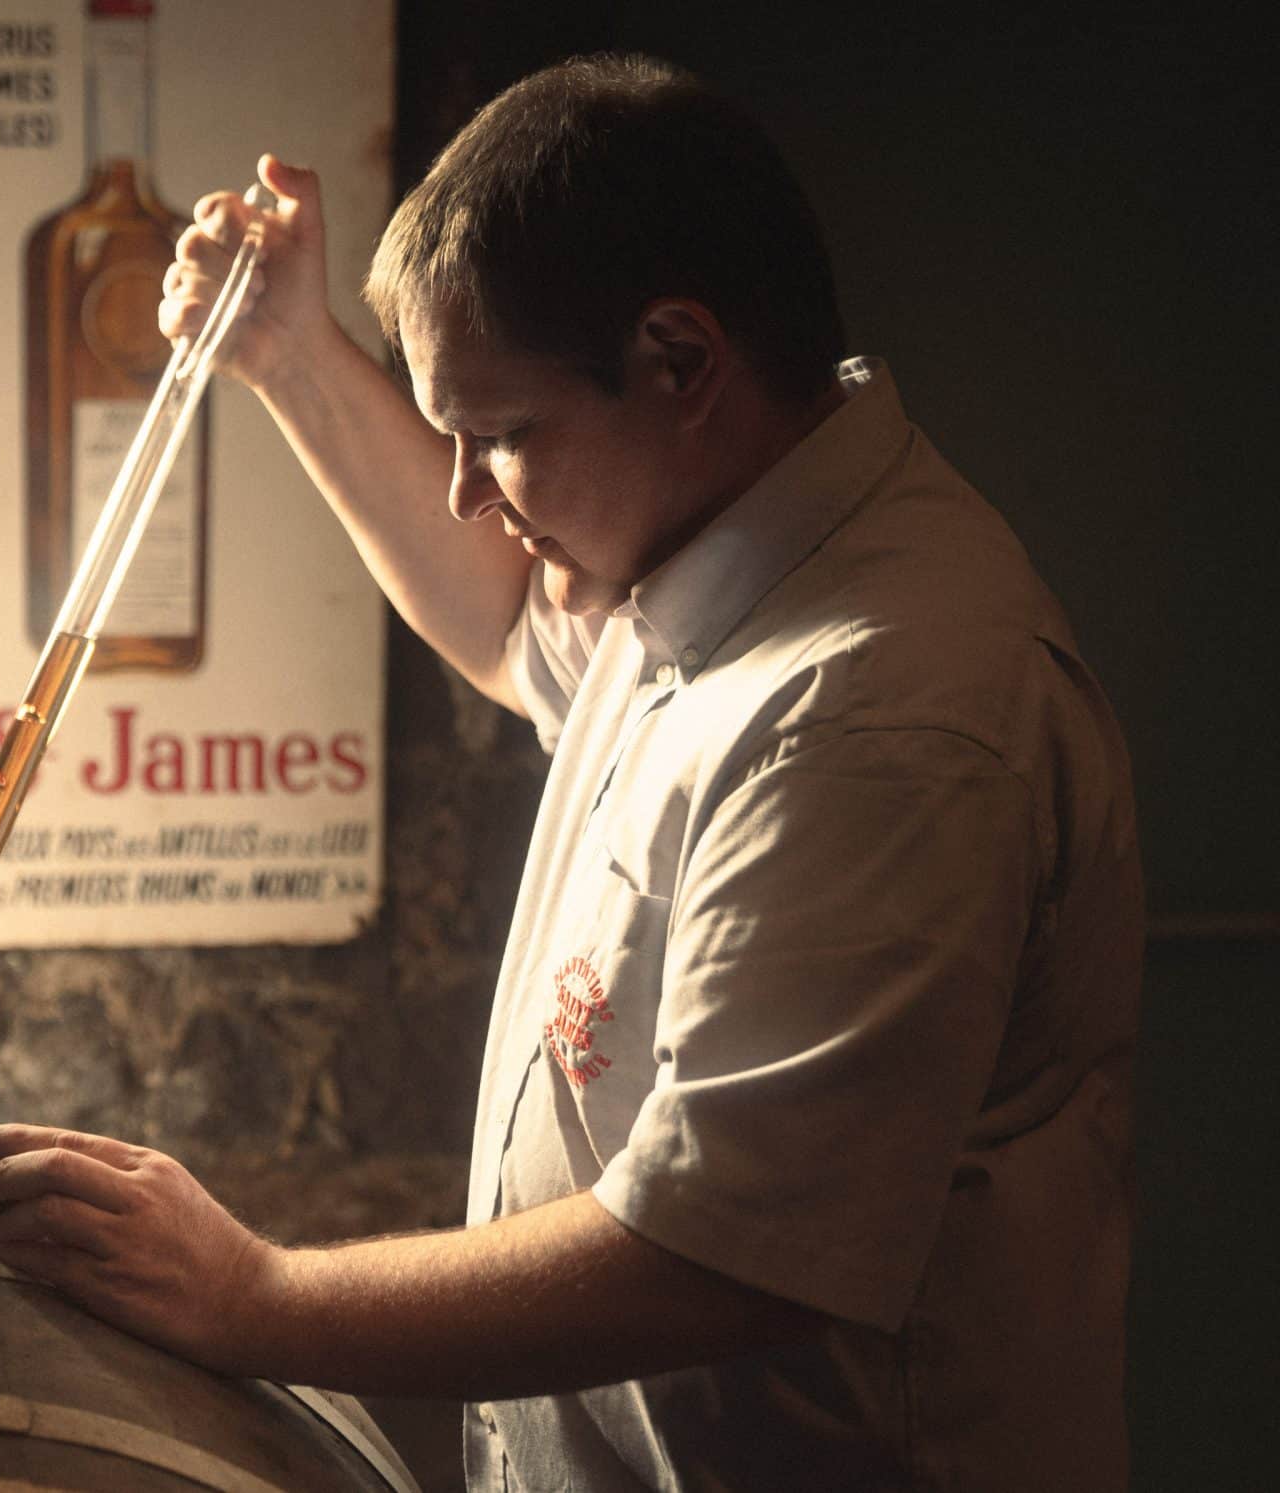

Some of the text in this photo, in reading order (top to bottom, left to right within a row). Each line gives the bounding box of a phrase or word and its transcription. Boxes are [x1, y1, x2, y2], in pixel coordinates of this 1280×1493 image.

[81, 705, 368, 795] James
[156, 824, 260, 859] ANTILLES
[11, 872, 127, 906] PREMIERS
[248, 867, 325, 901] MONDE
[557, 983, 594, 1027] SAINT
[554, 1008, 595, 1051] JAMES
